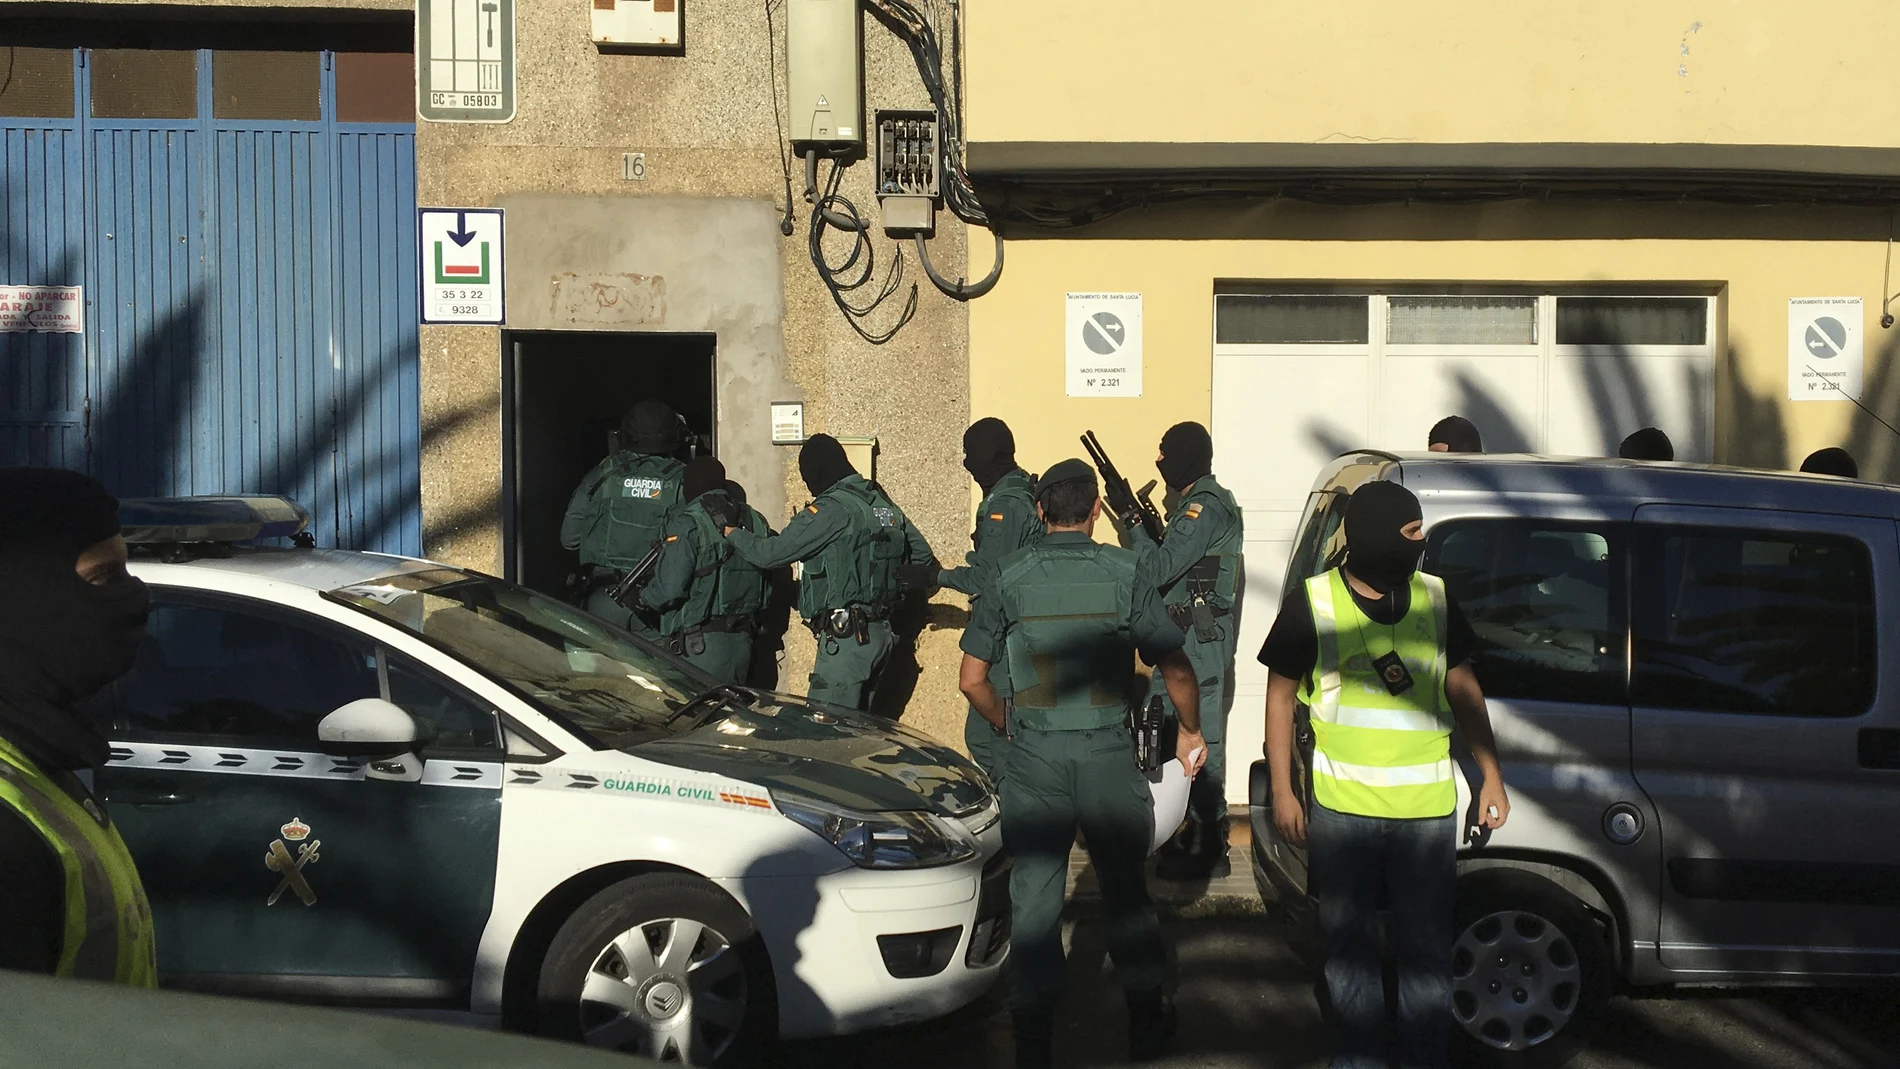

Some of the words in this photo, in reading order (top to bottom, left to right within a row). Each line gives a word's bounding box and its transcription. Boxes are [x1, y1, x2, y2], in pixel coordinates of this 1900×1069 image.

[463, 95, 497, 107] 05803
[624, 154, 644, 177] 16
[19, 292, 32, 301] NO
[35, 292, 76, 301] APARCAR
[442, 290, 456, 299] 35
[459, 290, 466, 299] 3
[470, 290, 483, 299] 22
[0, 302, 53, 312] ARAJE
[452, 305, 478, 314] 9328
[1101, 378, 1120, 387] 2.321
[624, 478, 661, 491] GUARDIA
[631, 488, 652, 498] CIVIL
[603, 778, 671, 795] GUARDIA
[677, 787, 716, 801] CIVIL
